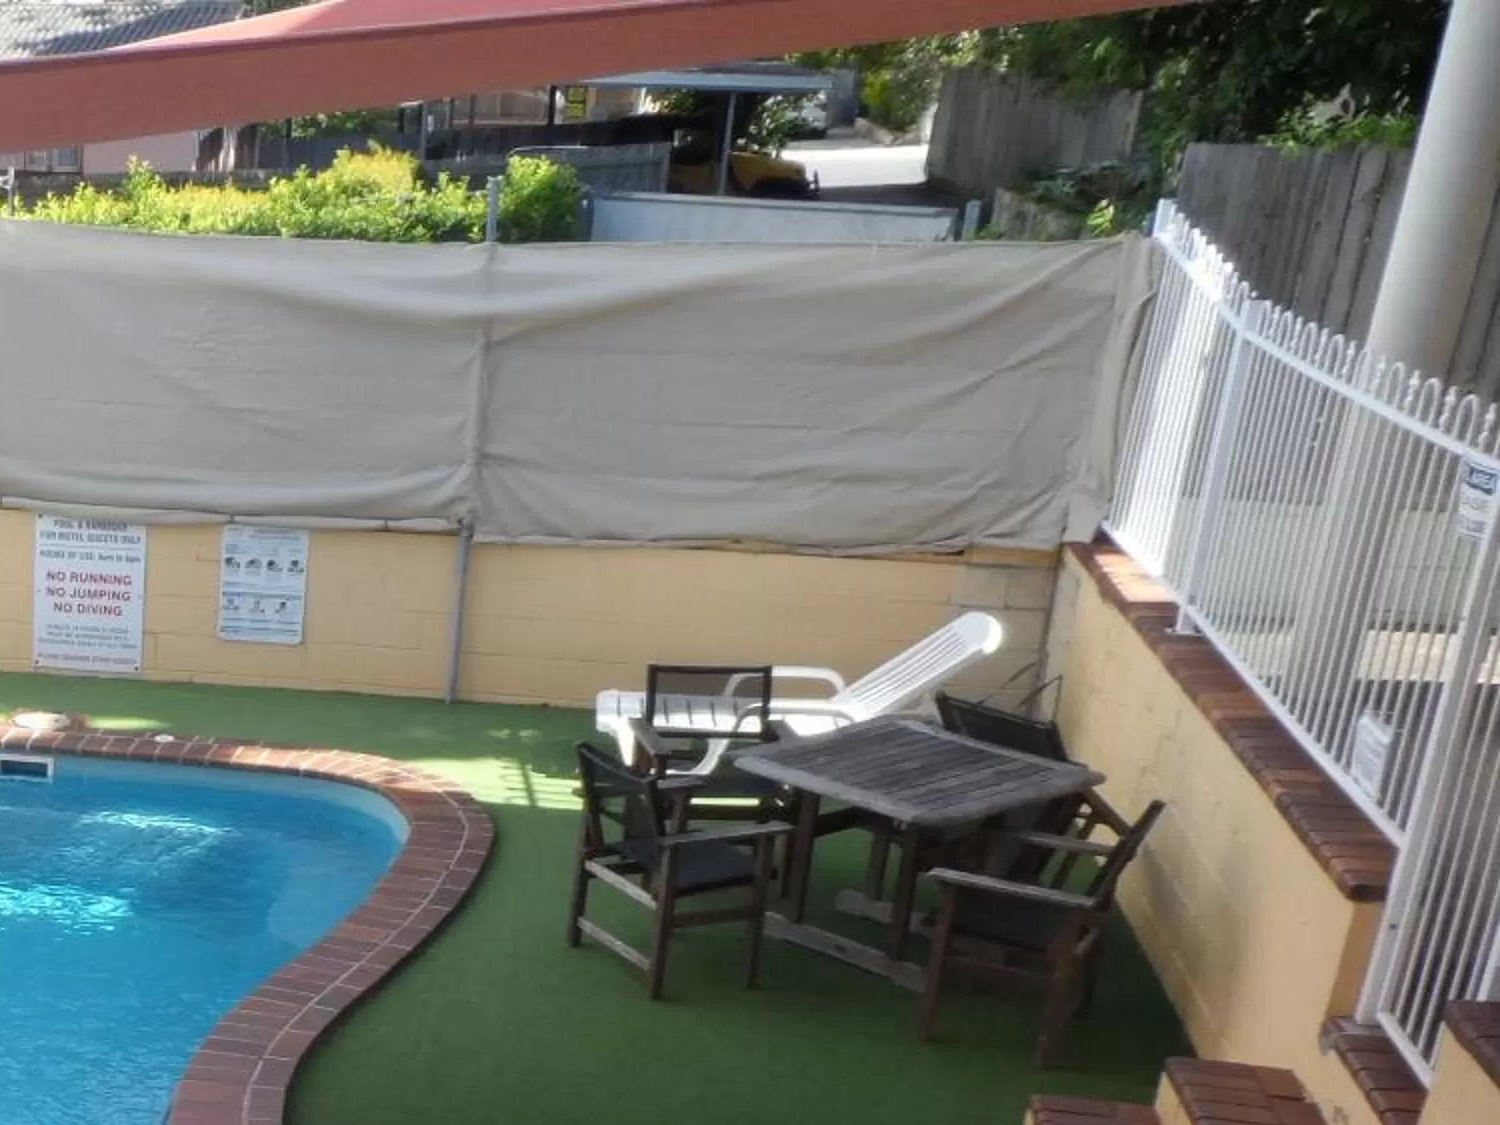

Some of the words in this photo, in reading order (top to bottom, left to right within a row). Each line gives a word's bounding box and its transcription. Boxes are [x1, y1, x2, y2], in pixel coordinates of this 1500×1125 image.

[46, 570, 66, 582] NO
[69, 571, 133, 586] RUNNING
[46, 586, 66, 598] NO
[69, 588, 132, 601] JUMPING
[53, 602, 73, 613] NO
[76, 603, 123, 617] DIVING
